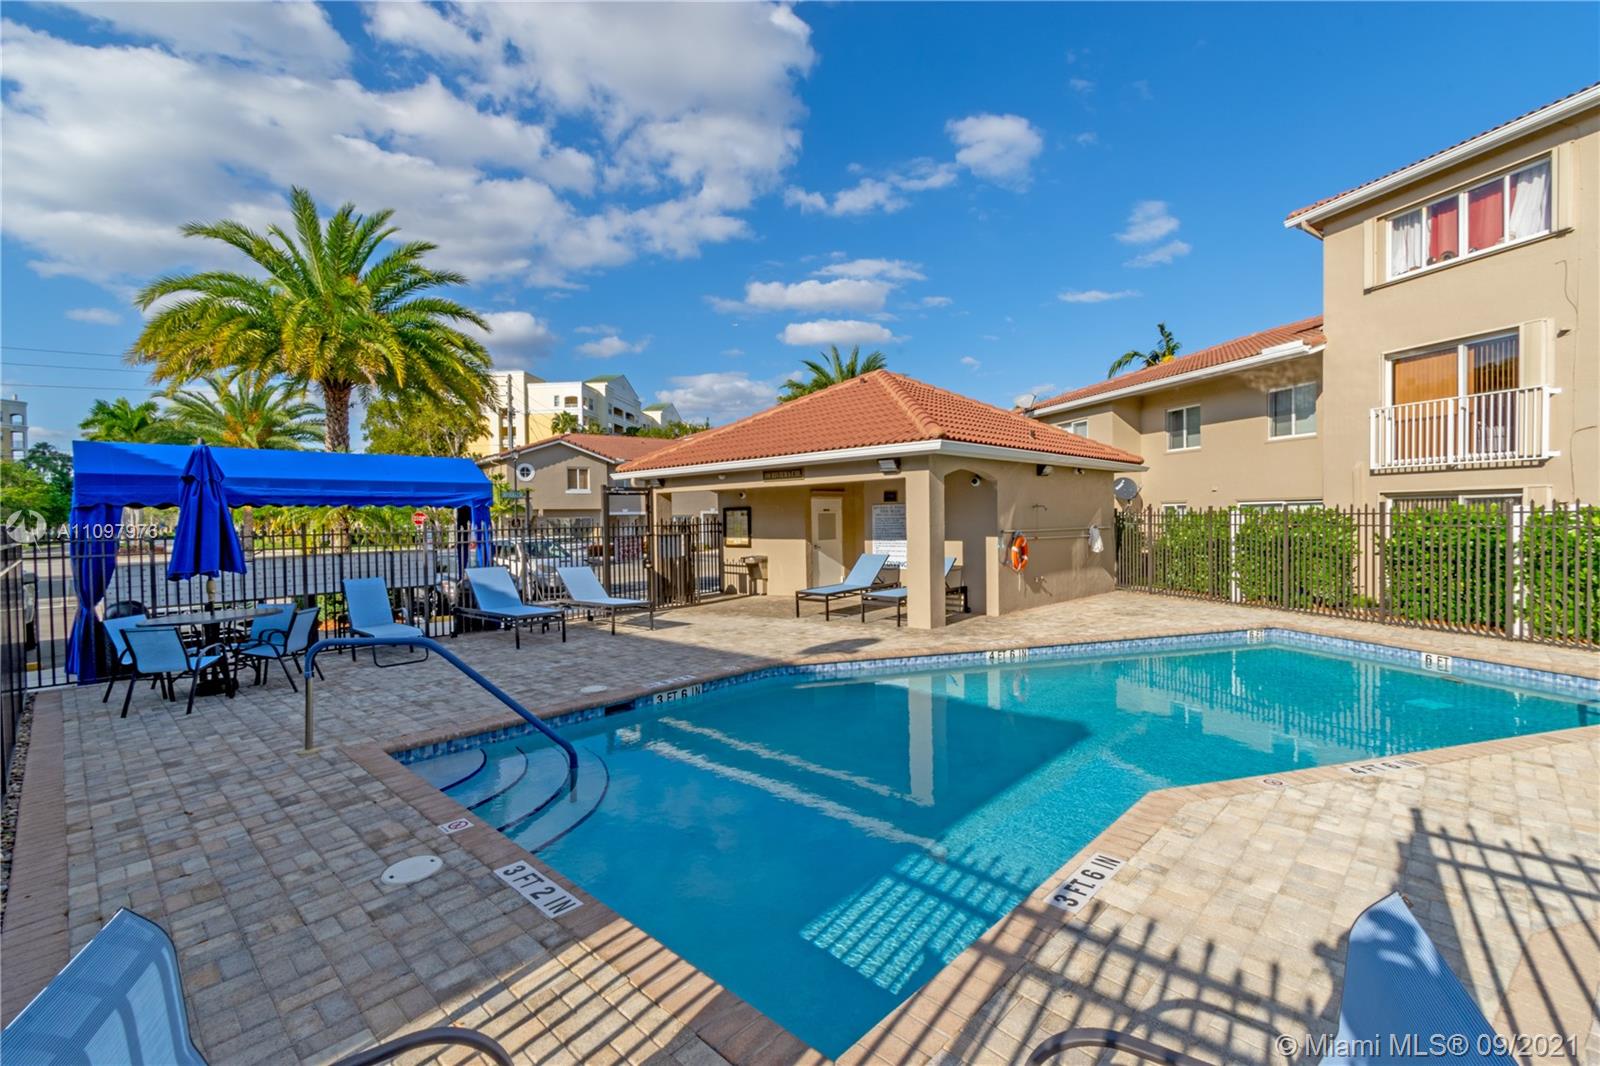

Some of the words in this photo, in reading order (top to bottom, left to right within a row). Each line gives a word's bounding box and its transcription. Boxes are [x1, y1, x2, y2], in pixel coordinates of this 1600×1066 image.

[656, 694, 664, 704] 3
[666, 690, 678, 702] FT
[691, 685, 701, 697] IN
[503, 865, 526, 876] 3
[1090, 854, 1121, 871] IN
[513, 872, 544, 889] FT
[1080, 869, 1106, 880] 6
[529, 886, 556, 901] 2
[1053, 894, 1079, 907] 3
[543, 895, 577, 915] IN
